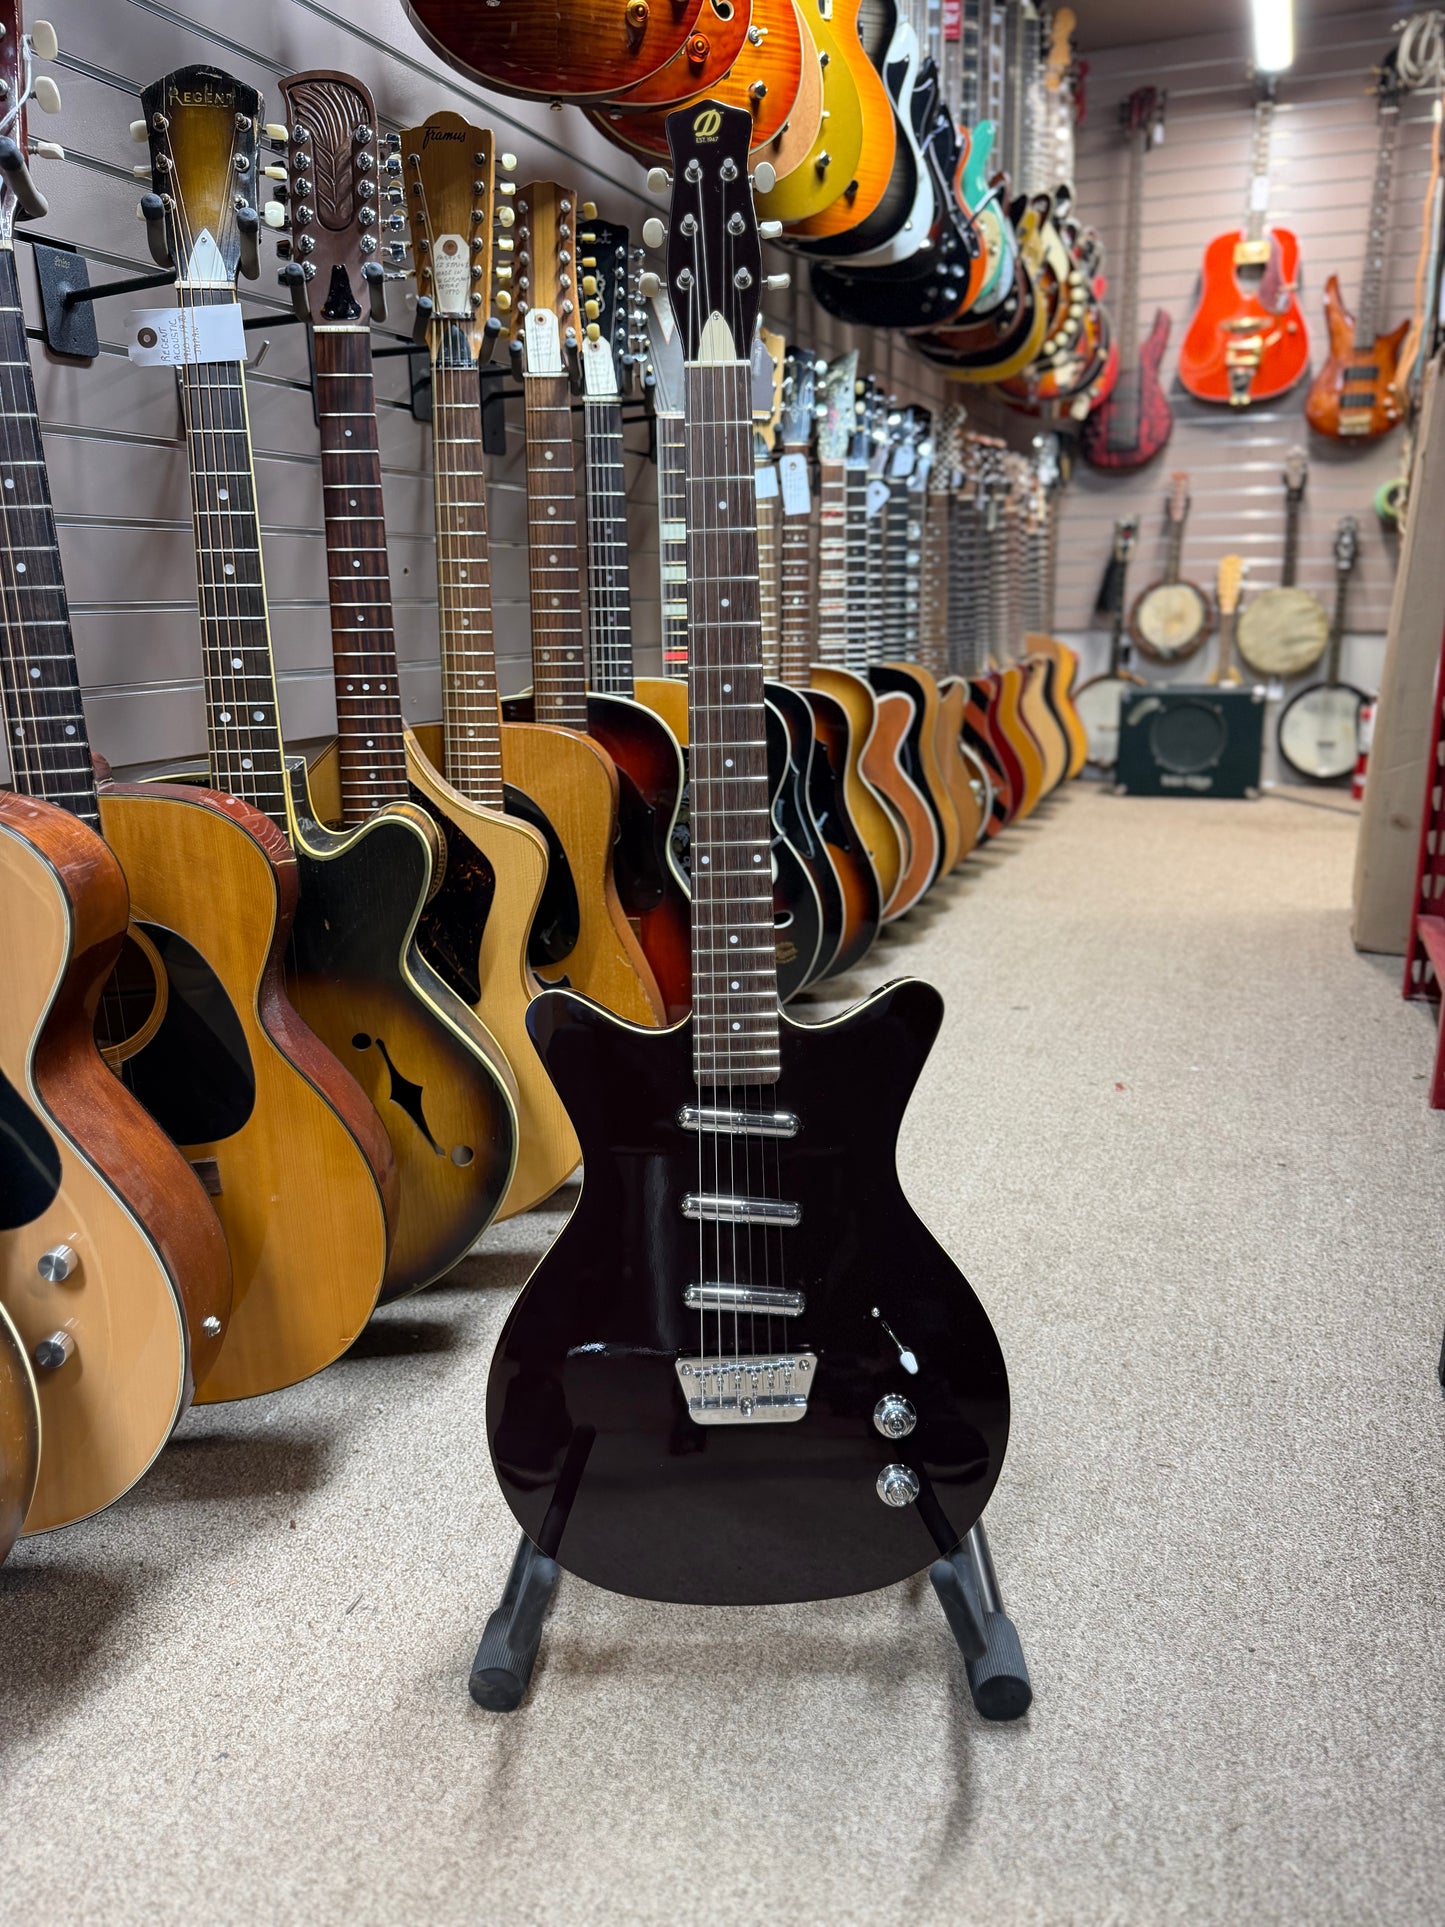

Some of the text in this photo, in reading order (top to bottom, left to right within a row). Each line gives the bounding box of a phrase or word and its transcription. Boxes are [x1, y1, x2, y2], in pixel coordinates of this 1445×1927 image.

[169, 86, 234, 106] REGENT
[422, 126, 466, 150] Framus
[158, 326, 171, 362] REGENT
[168, 318, 182, 361] ACOUSTIC
